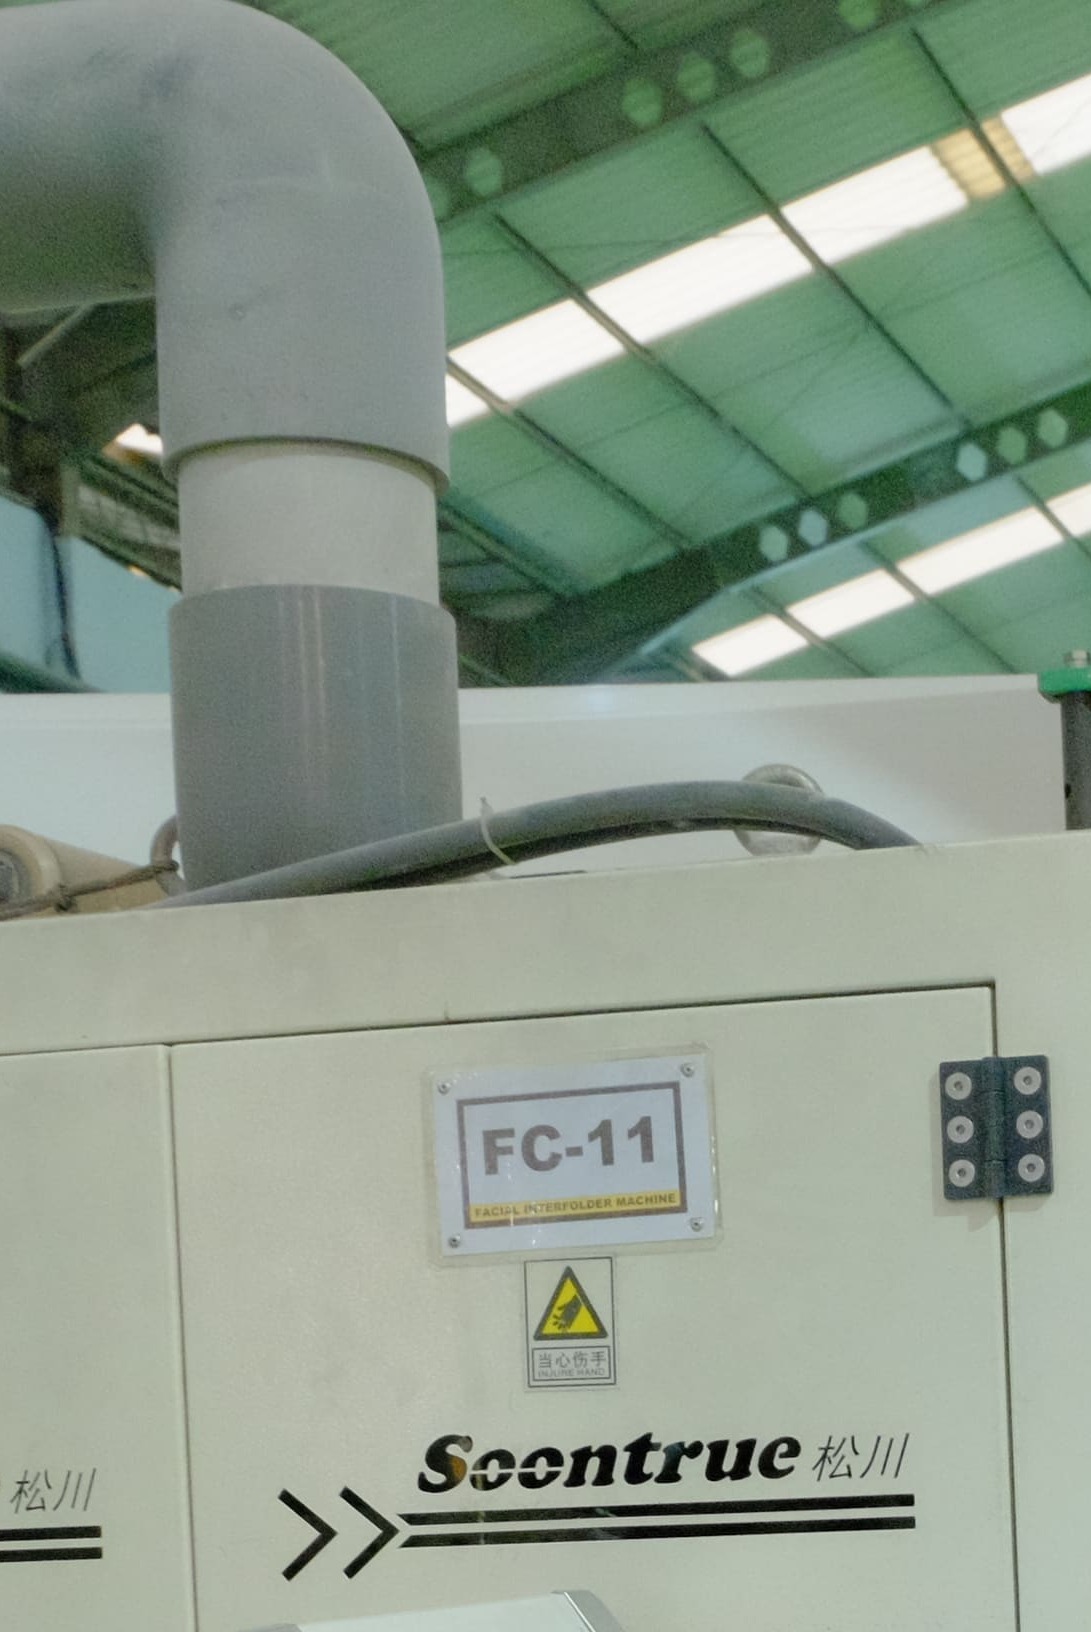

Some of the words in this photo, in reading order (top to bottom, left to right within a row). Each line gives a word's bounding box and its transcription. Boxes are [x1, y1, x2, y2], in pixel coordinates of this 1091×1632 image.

[482, 1115, 655, 1176] FC-11
[475, 1206, 518, 1219] FACIAL
[523, 1198, 613, 1215] INTERFOLDER
[616, 1192, 677, 1207] MACHINE
[538, 1350, 607, 1369] 当心伤手
[576, 1367, 605, 1377] HAND
[418, 1431, 801, 1494] Soontrue
[812, 1432, 910, 1482] 松川
[10, 1467, 97, 1514] 松川
